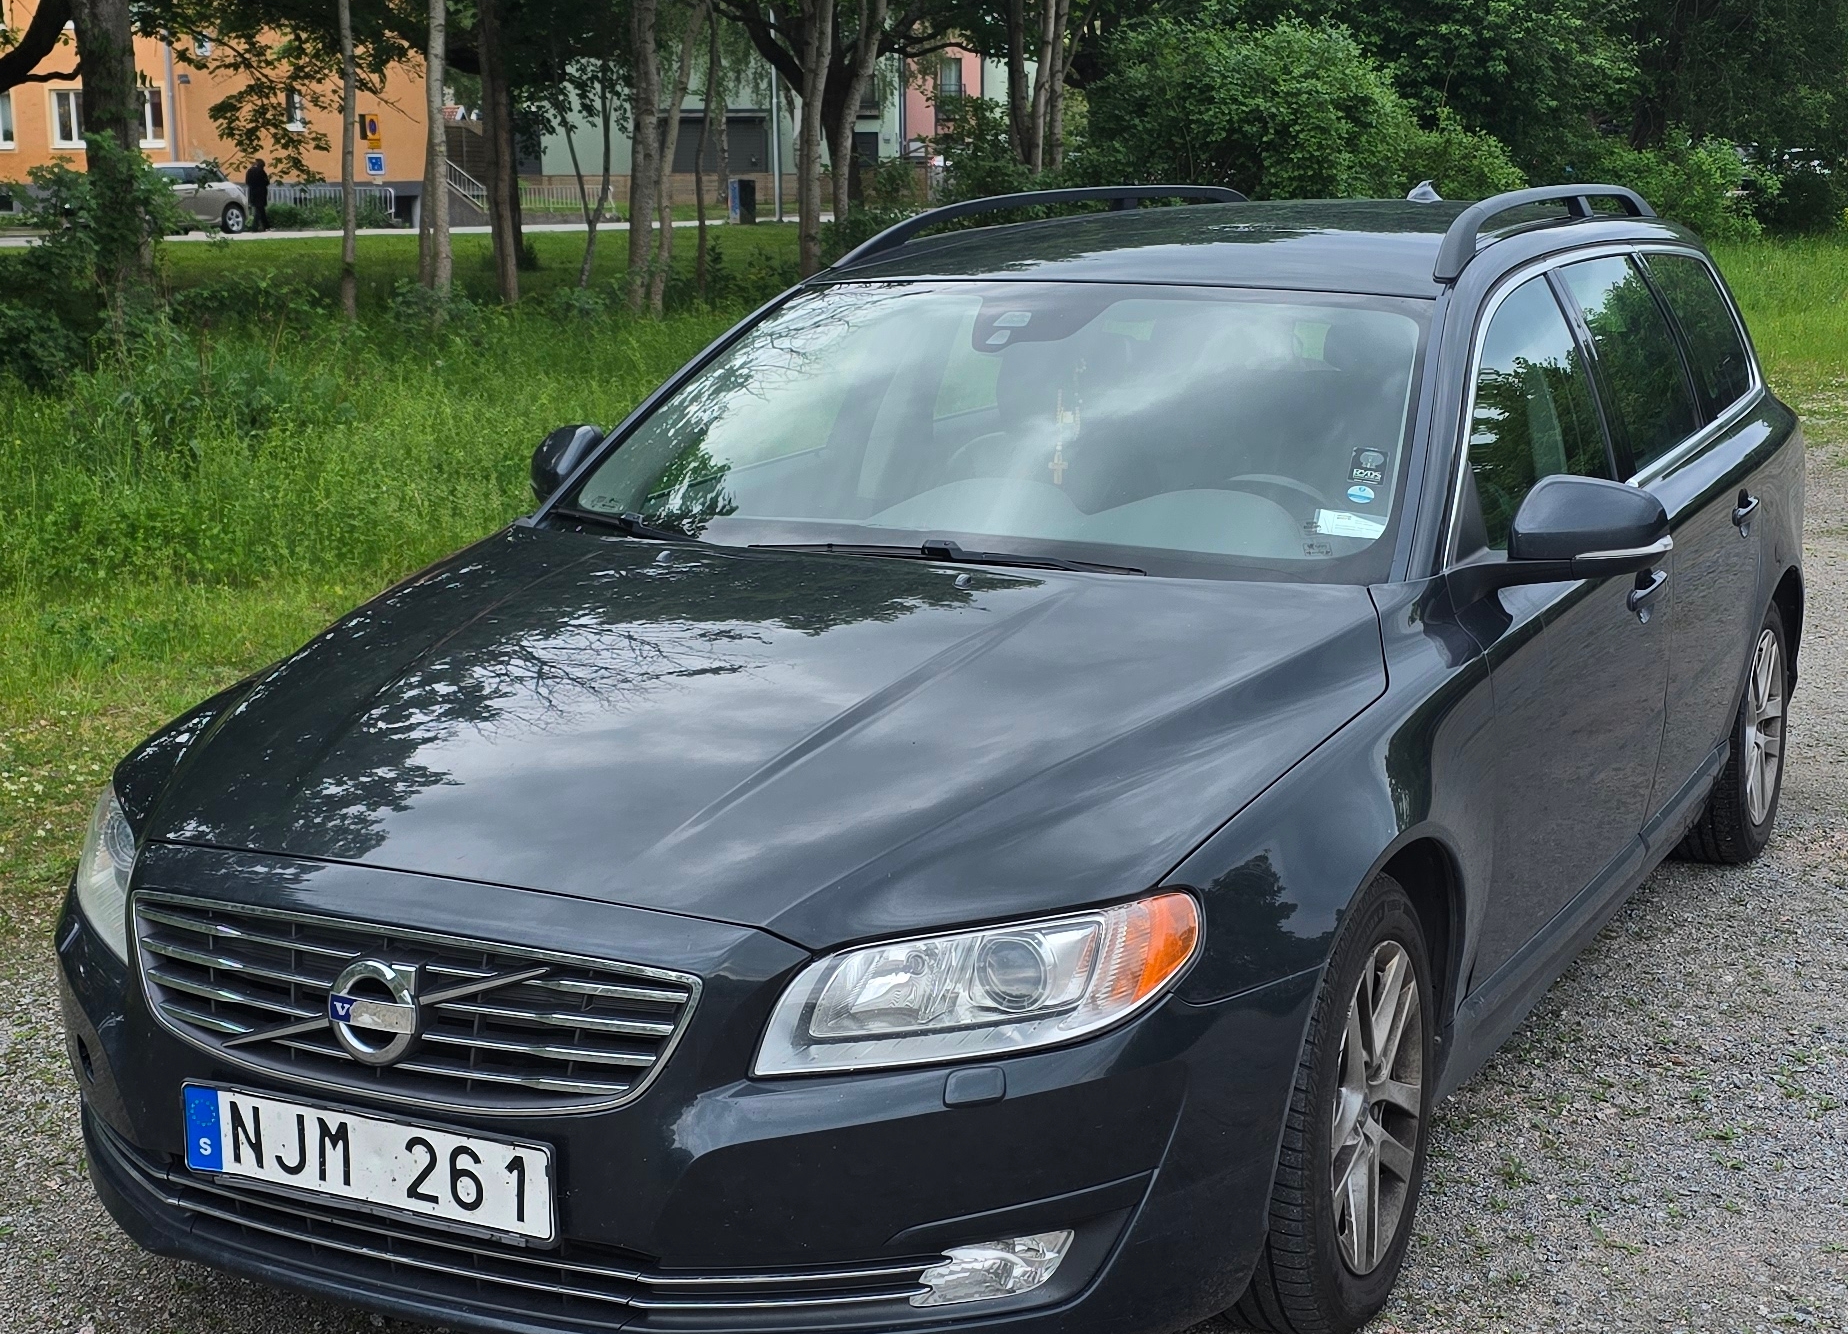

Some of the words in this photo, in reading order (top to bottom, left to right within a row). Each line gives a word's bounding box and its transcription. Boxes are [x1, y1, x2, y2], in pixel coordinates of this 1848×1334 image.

[199, 1137, 212, 1156] S
[229, 1100, 351, 1187] NJM
[404, 1136, 526, 1223] 261
